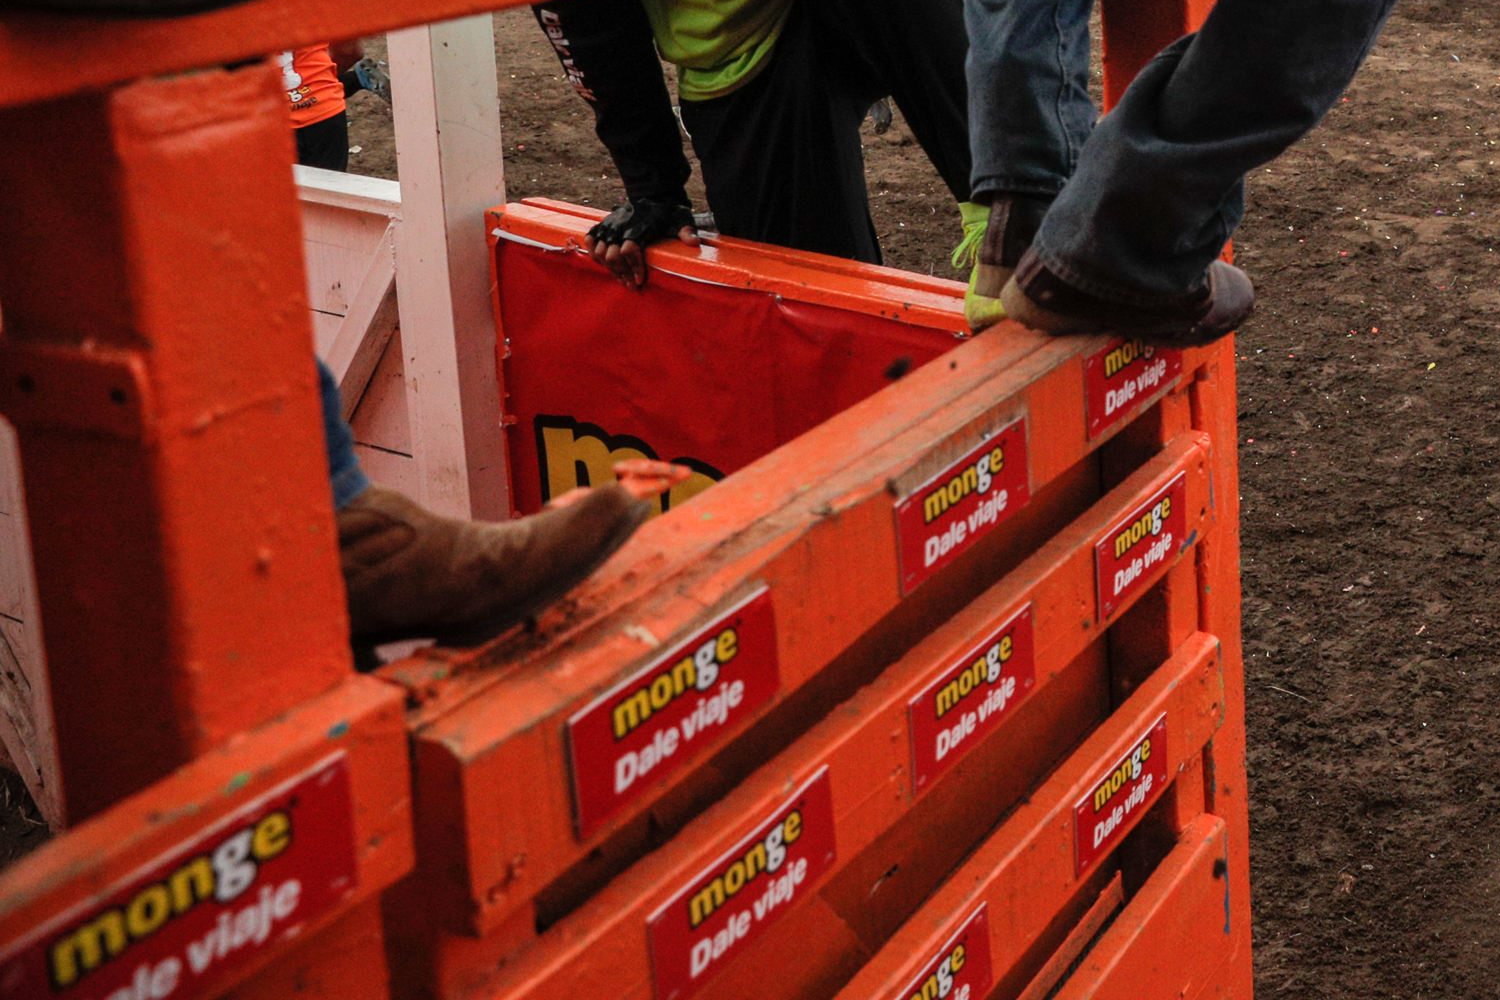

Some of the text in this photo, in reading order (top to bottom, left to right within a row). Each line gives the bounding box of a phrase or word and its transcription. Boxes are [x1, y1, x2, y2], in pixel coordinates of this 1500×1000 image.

[1105, 359, 1166, 416] Dale viaje
[924, 445, 1005, 526] monge
[924, 488, 1008, 567] Dale viaje
[1115, 496, 1171, 559] monge
[1114, 532, 1172, 596] Dale viaje
[613, 627, 739, 740] monge
[936, 635, 1012, 720] monge
[936, 676, 1016, 762] Dale viaje
[615, 680, 744, 794] Dale viaje
[1094, 738, 1151, 813] monge
[1094, 773, 1153, 849] Dale viaje
[49, 811, 292, 988] monge
[690, 811, 802, 929] monge
[186, 879, 301, 974] viaje
[690, 857, 808, 978] Dale viaje
